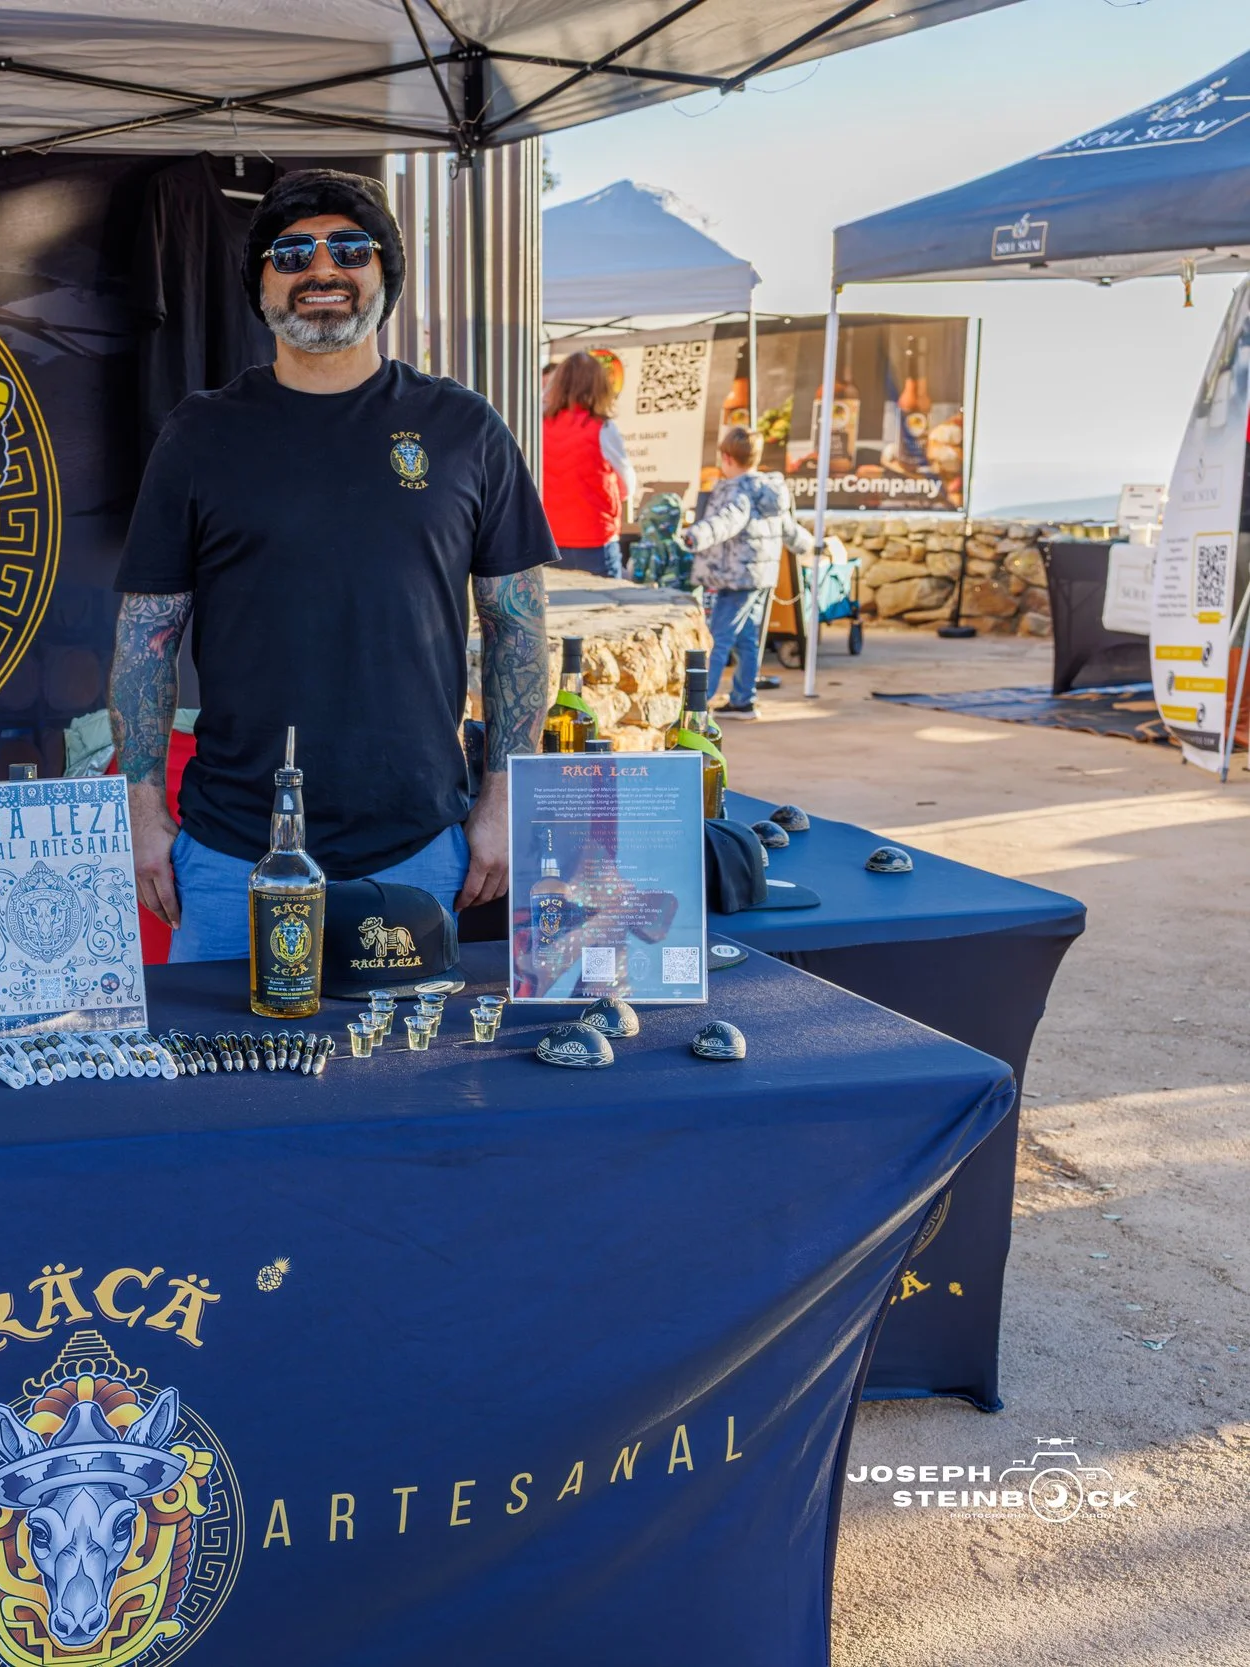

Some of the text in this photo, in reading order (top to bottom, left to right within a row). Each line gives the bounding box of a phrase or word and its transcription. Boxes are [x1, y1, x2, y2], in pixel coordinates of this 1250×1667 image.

[785, 474, 942, 498] epperCompany
[50, 802, 130, 837] LEZA
[30, 833, 132, 859] ARTESANAL
[262, 1415, 743, 1549] ARTESANAL
